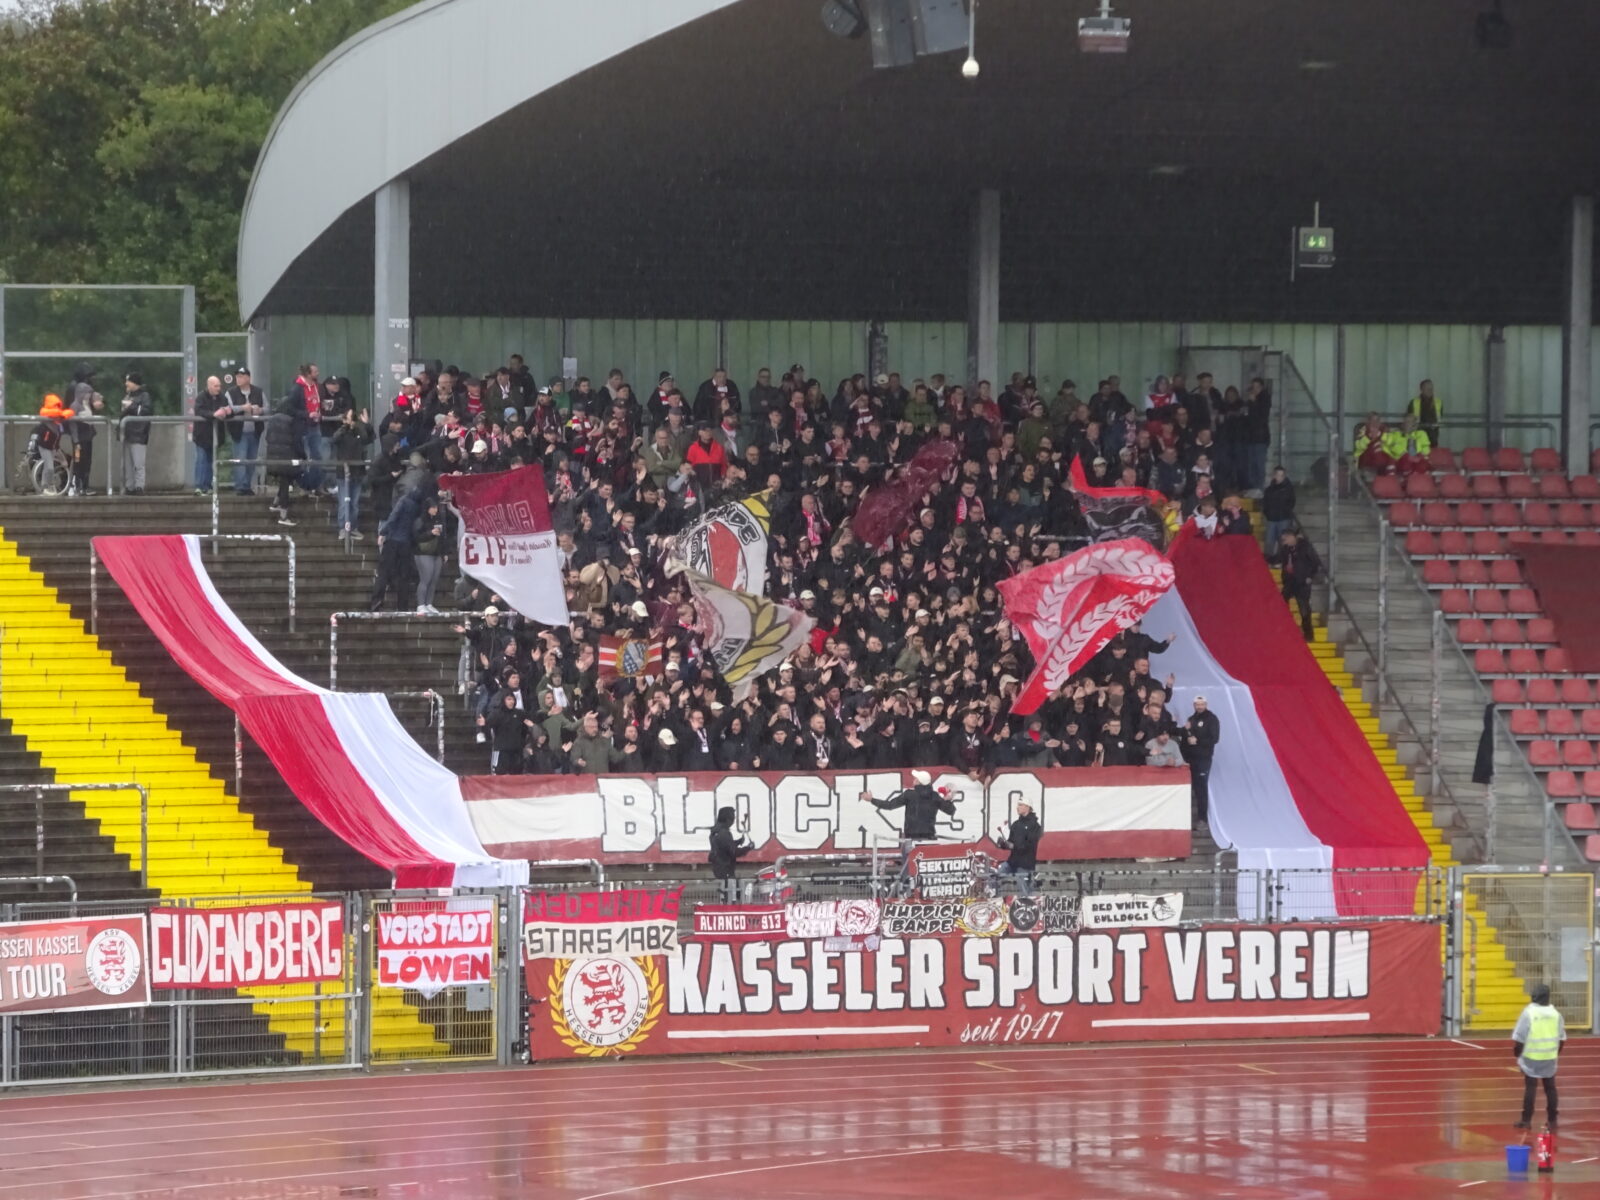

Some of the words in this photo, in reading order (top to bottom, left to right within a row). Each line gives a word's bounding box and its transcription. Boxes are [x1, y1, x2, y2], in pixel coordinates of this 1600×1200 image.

[598, 772, 902, 853] BLOCK
[914, 773, 1044, 851] 30
[919, 858, 970, 873] SEKTION
[526, 890, 680, 918] RED-WHITE
[1042, 896, 1081, 913] JUGEND
[1092, 903, 1113, 911] RED
[1116, 901, 1149, 910] WHITE
[379, 912, 491, 946] VORSTADT
[700, 915, 747, 931] ALIANCO
[761, 914, 781, 930] 913
[786, 919, 836, 938] CREW
[890, 917, 954, 934] BANDE
[1044, 912, 1079, 930] BANDE
[1094, 913, 1149, 924] BULLDOGS
[36, 935, 83, 956] KASSEL
[150, 906, 342, 983] GUDENSBERG
[528, 927, 613, 954] STARS
[616, 925, 676, 952] 1982
[379, 950, 491, 983] LÖWEN
[666, 937, 946, 1014] KASSELER
[963, 931, 1147, 1008] SPORT
[1164, 929, 1370, 1002] VEREIN
[7, 962, 67, 1000] TOUR
[565, 1008, 604, 1044] HESSEN
[618, 994, 648, 1039] KASSEL
[960, 1017, 1002, 1043] seit
[1003, 1011, 1064, 1042] 1947
